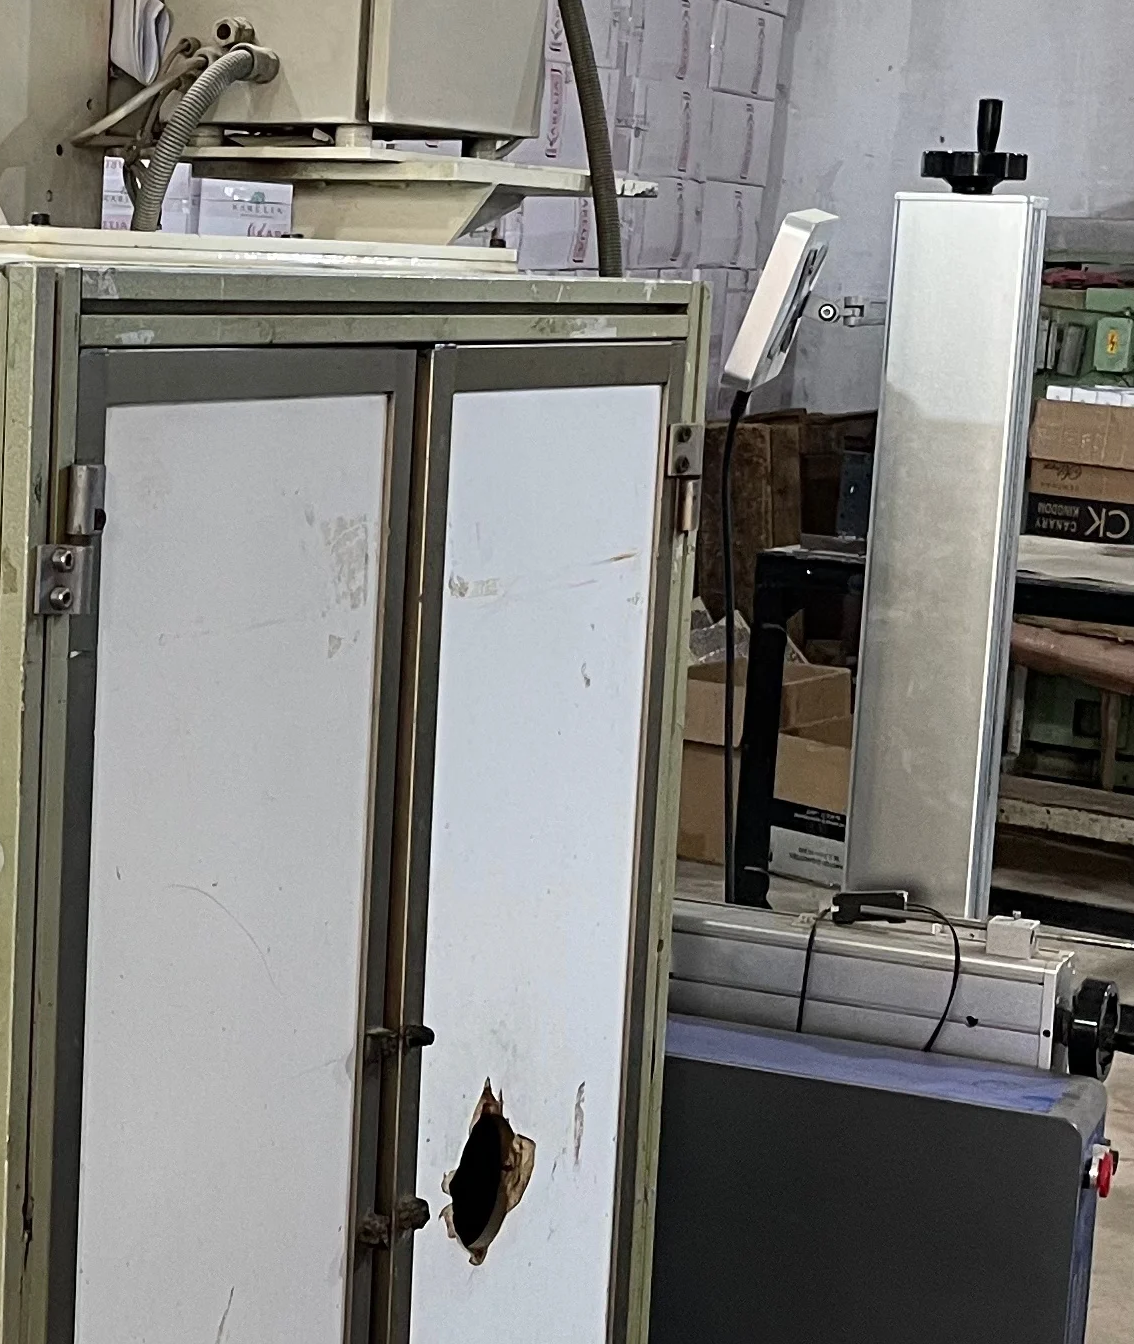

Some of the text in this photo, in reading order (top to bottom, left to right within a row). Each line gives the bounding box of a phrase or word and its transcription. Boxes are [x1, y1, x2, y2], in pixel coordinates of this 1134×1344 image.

[1037, 502, 1080, 518] KINGDOM
[1035, 517, 1077, 533] CANARY
[1083, 505, 1130, 539] CK
